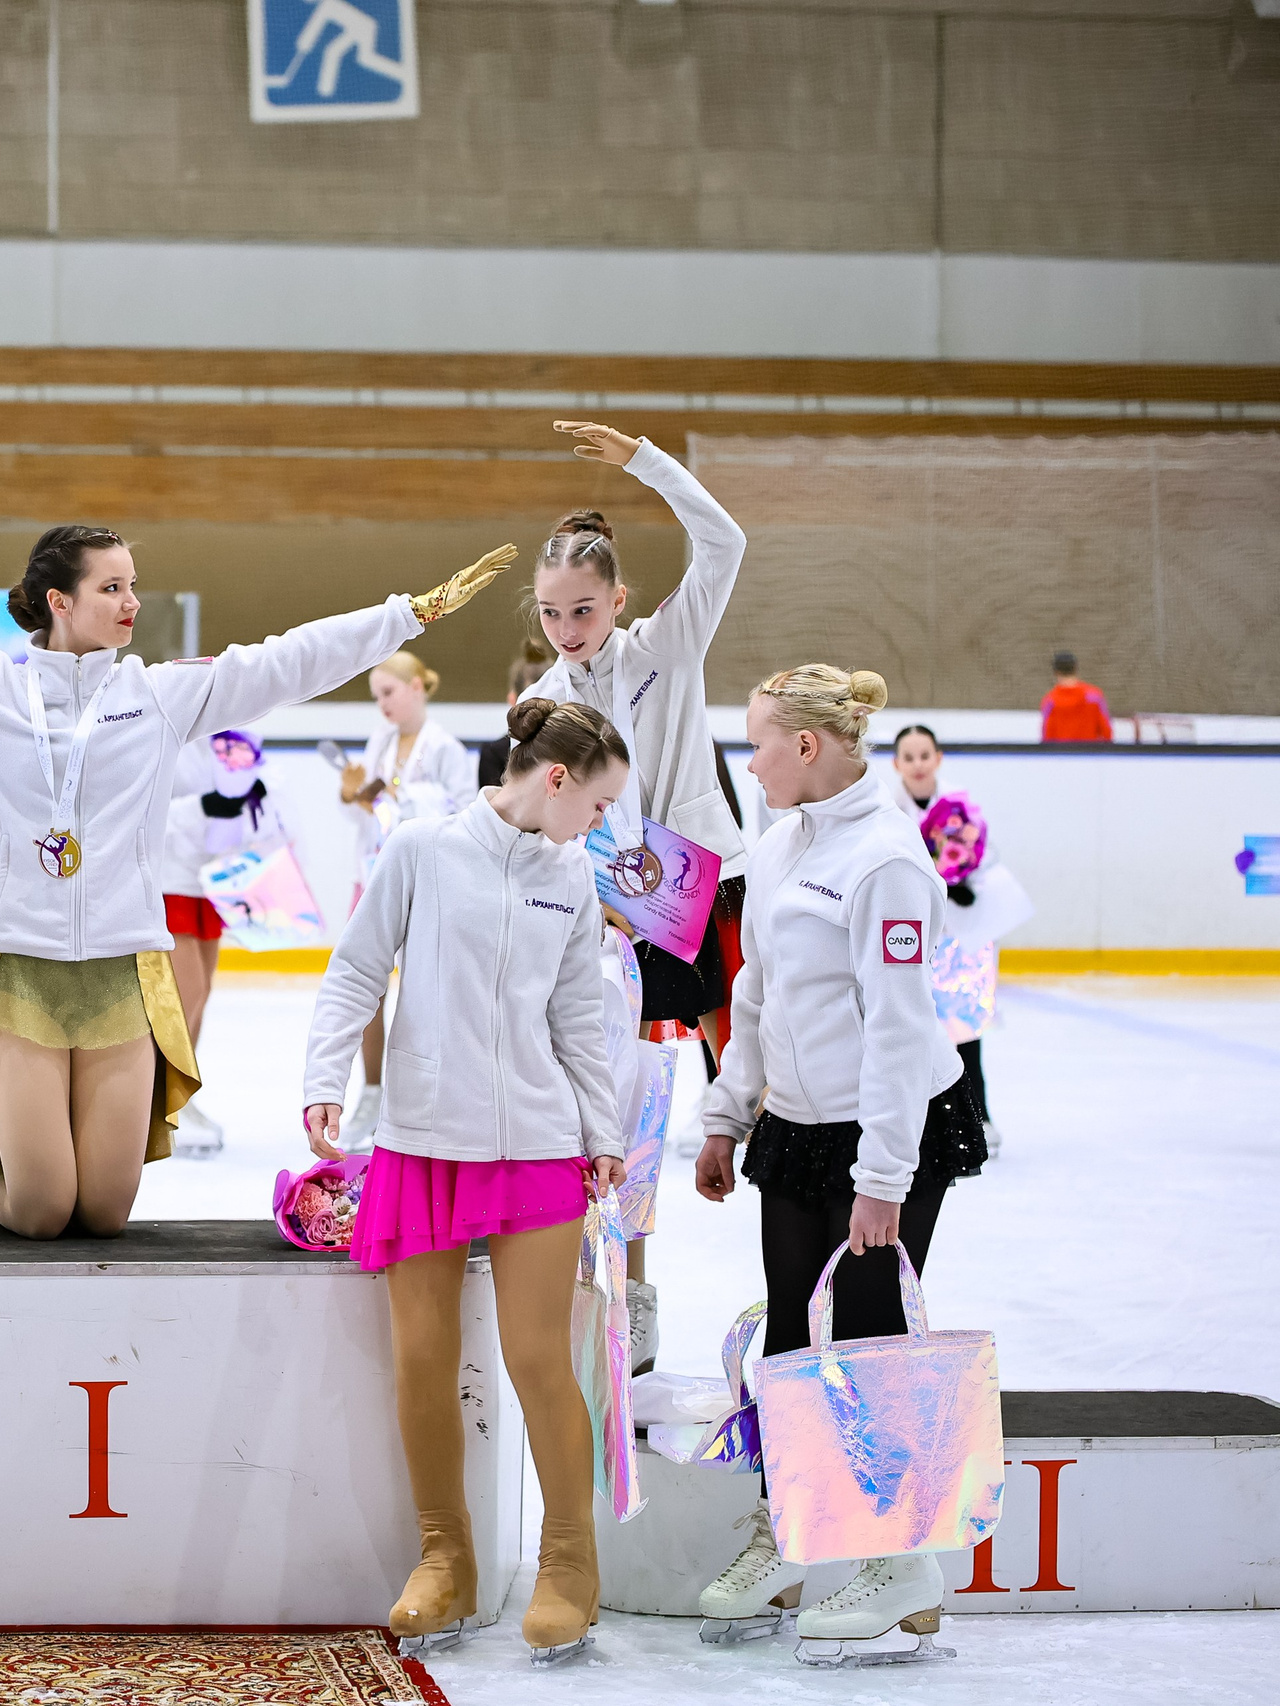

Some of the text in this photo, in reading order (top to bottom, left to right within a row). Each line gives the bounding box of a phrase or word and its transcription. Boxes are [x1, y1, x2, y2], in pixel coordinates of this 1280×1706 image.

[630, 669, 659, 711] ХАНГЕЛЬСК
[531, 897, 576, 915] АРХАНГЕЛЬСК
[887, 936, 917, 946] CANDY
[69, 1381, 128, 1518] I
